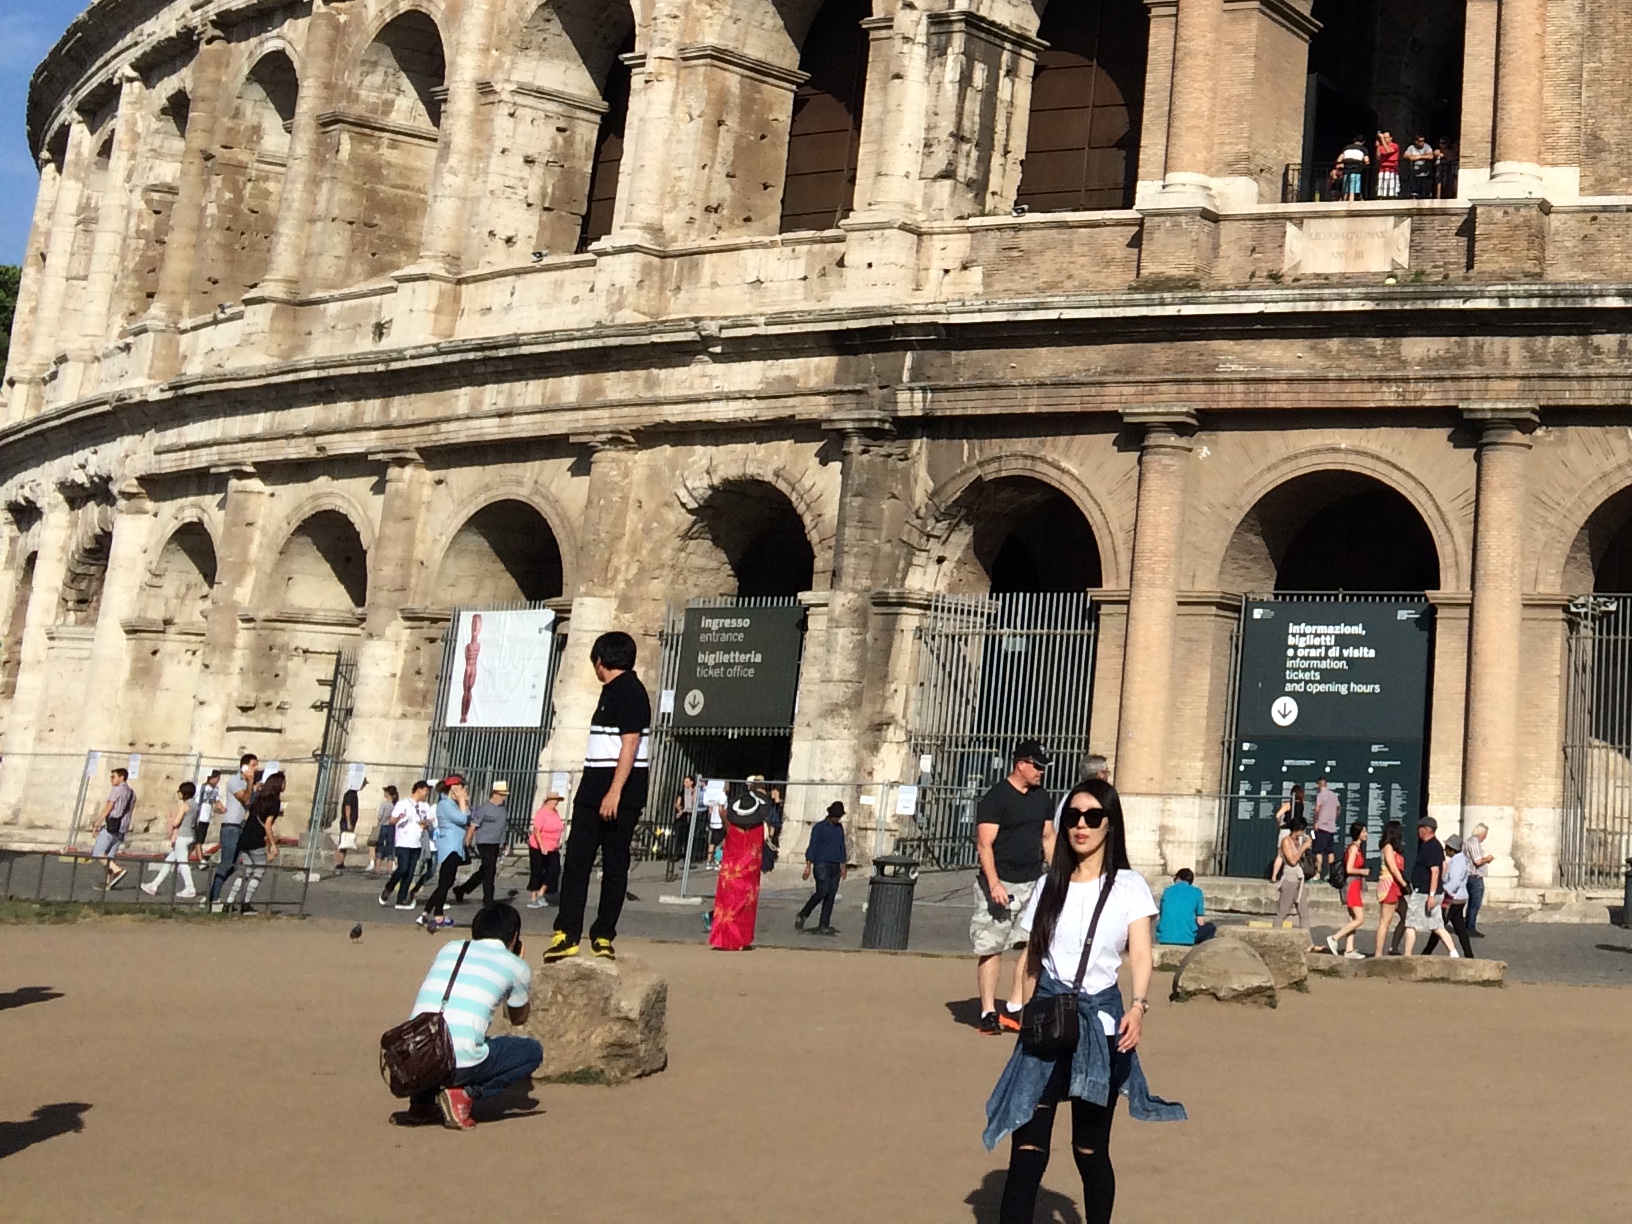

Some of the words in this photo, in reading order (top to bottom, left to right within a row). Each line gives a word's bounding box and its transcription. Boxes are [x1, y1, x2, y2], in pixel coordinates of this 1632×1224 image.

[700, 615, 751, 631] ingresso
[1288, 622, 1366, 636] informazioni,
[699, 631, 745, 643] entrance
[1287, 634, 1335, 647] biglietti
[697, 650, 762, 666] biglietteria
[1286, 648, 1294, 657] e
[1297, 646, 1325, 657] orari
[1327, 646, 1340, 657] di
[1342, 646, 1376, 658] visita
[1285, 657, 1349, 670] information,
[696, 665, 725, 678] ticket
[726, 665, 755, 678] office
[1285, 669, 1321, 681] tickets
[1284, 681, 1304, 692] and
[1306, 681, 1348, 695] opening
[1350, 681, 1381, 693] hours
